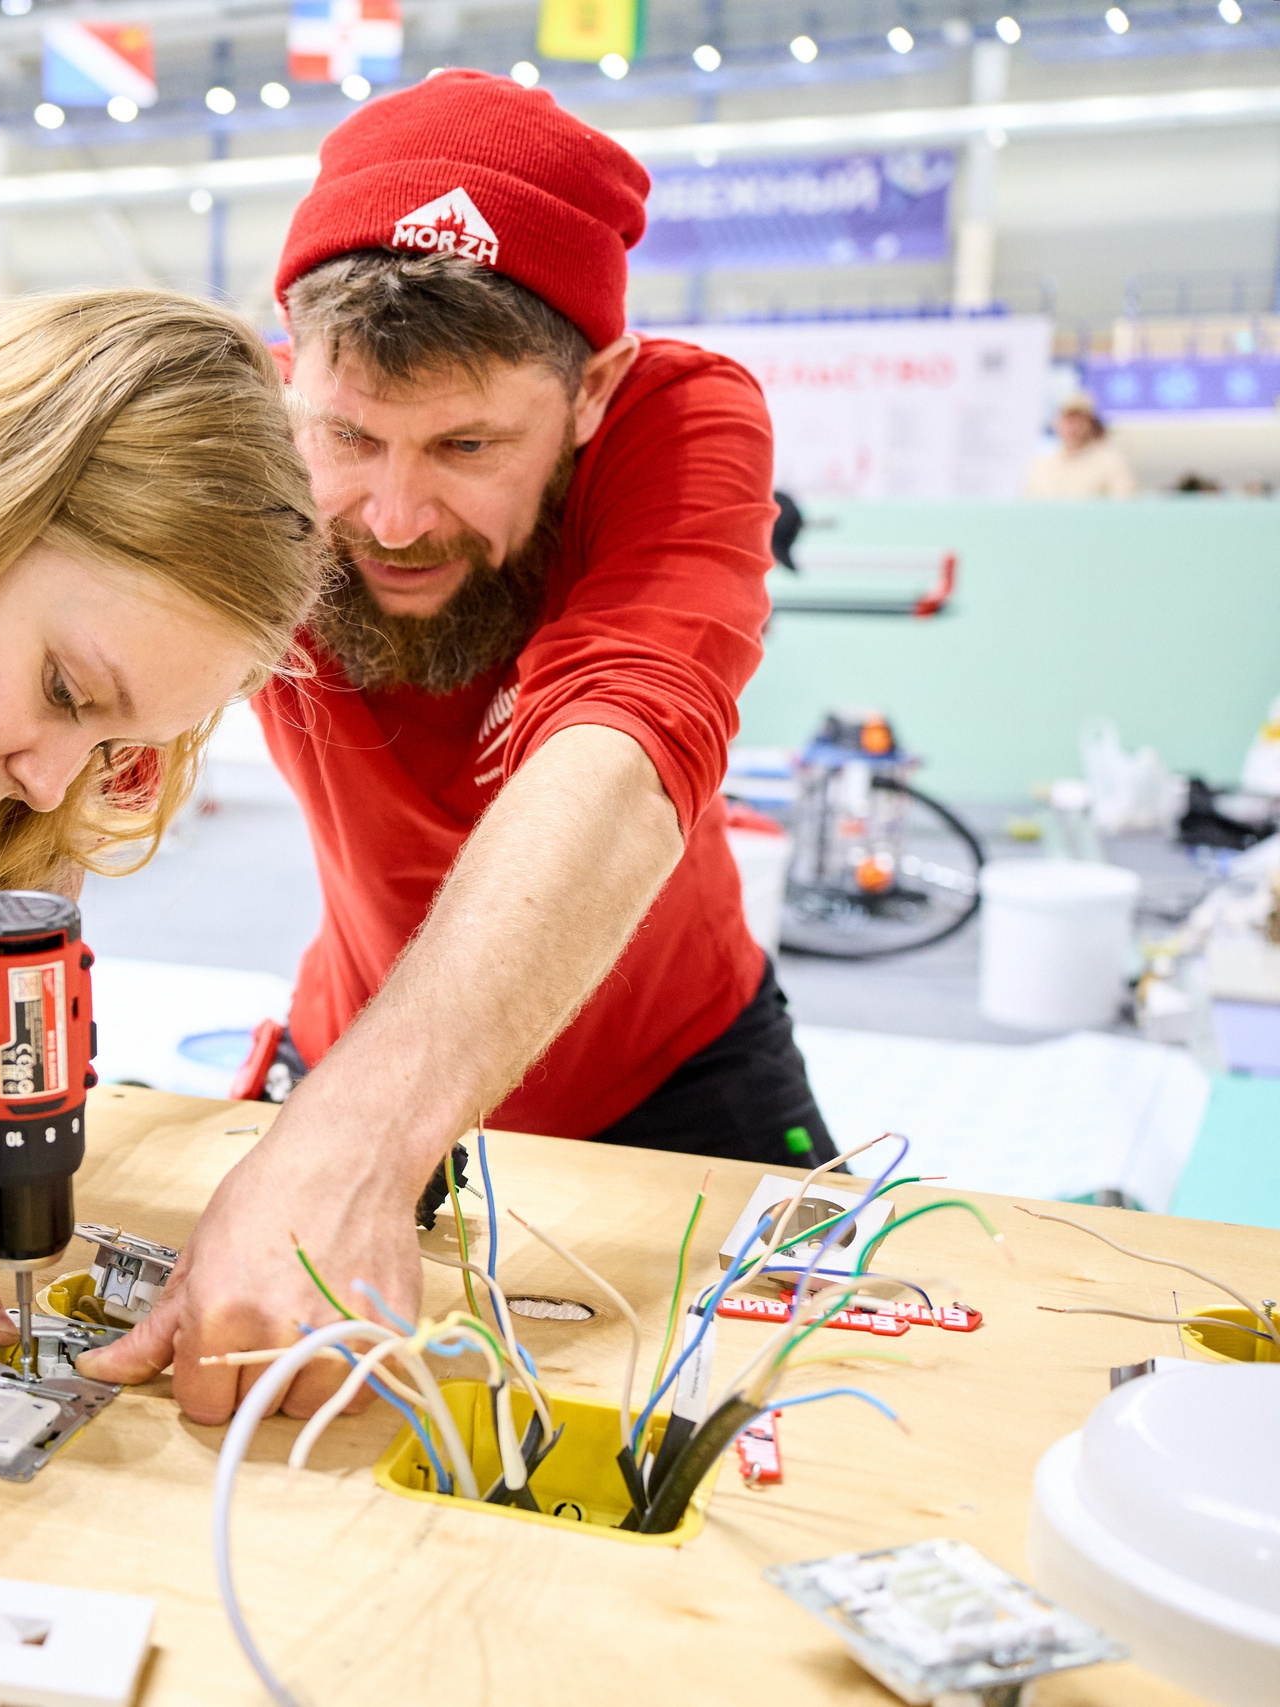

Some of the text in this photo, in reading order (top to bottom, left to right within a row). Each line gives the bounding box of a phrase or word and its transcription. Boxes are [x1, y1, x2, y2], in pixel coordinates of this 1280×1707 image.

[392, 225, 499, 265] MORZH
[5, 1131, 24, 1147] 10
[45, 1127, 56, 1143] 8
